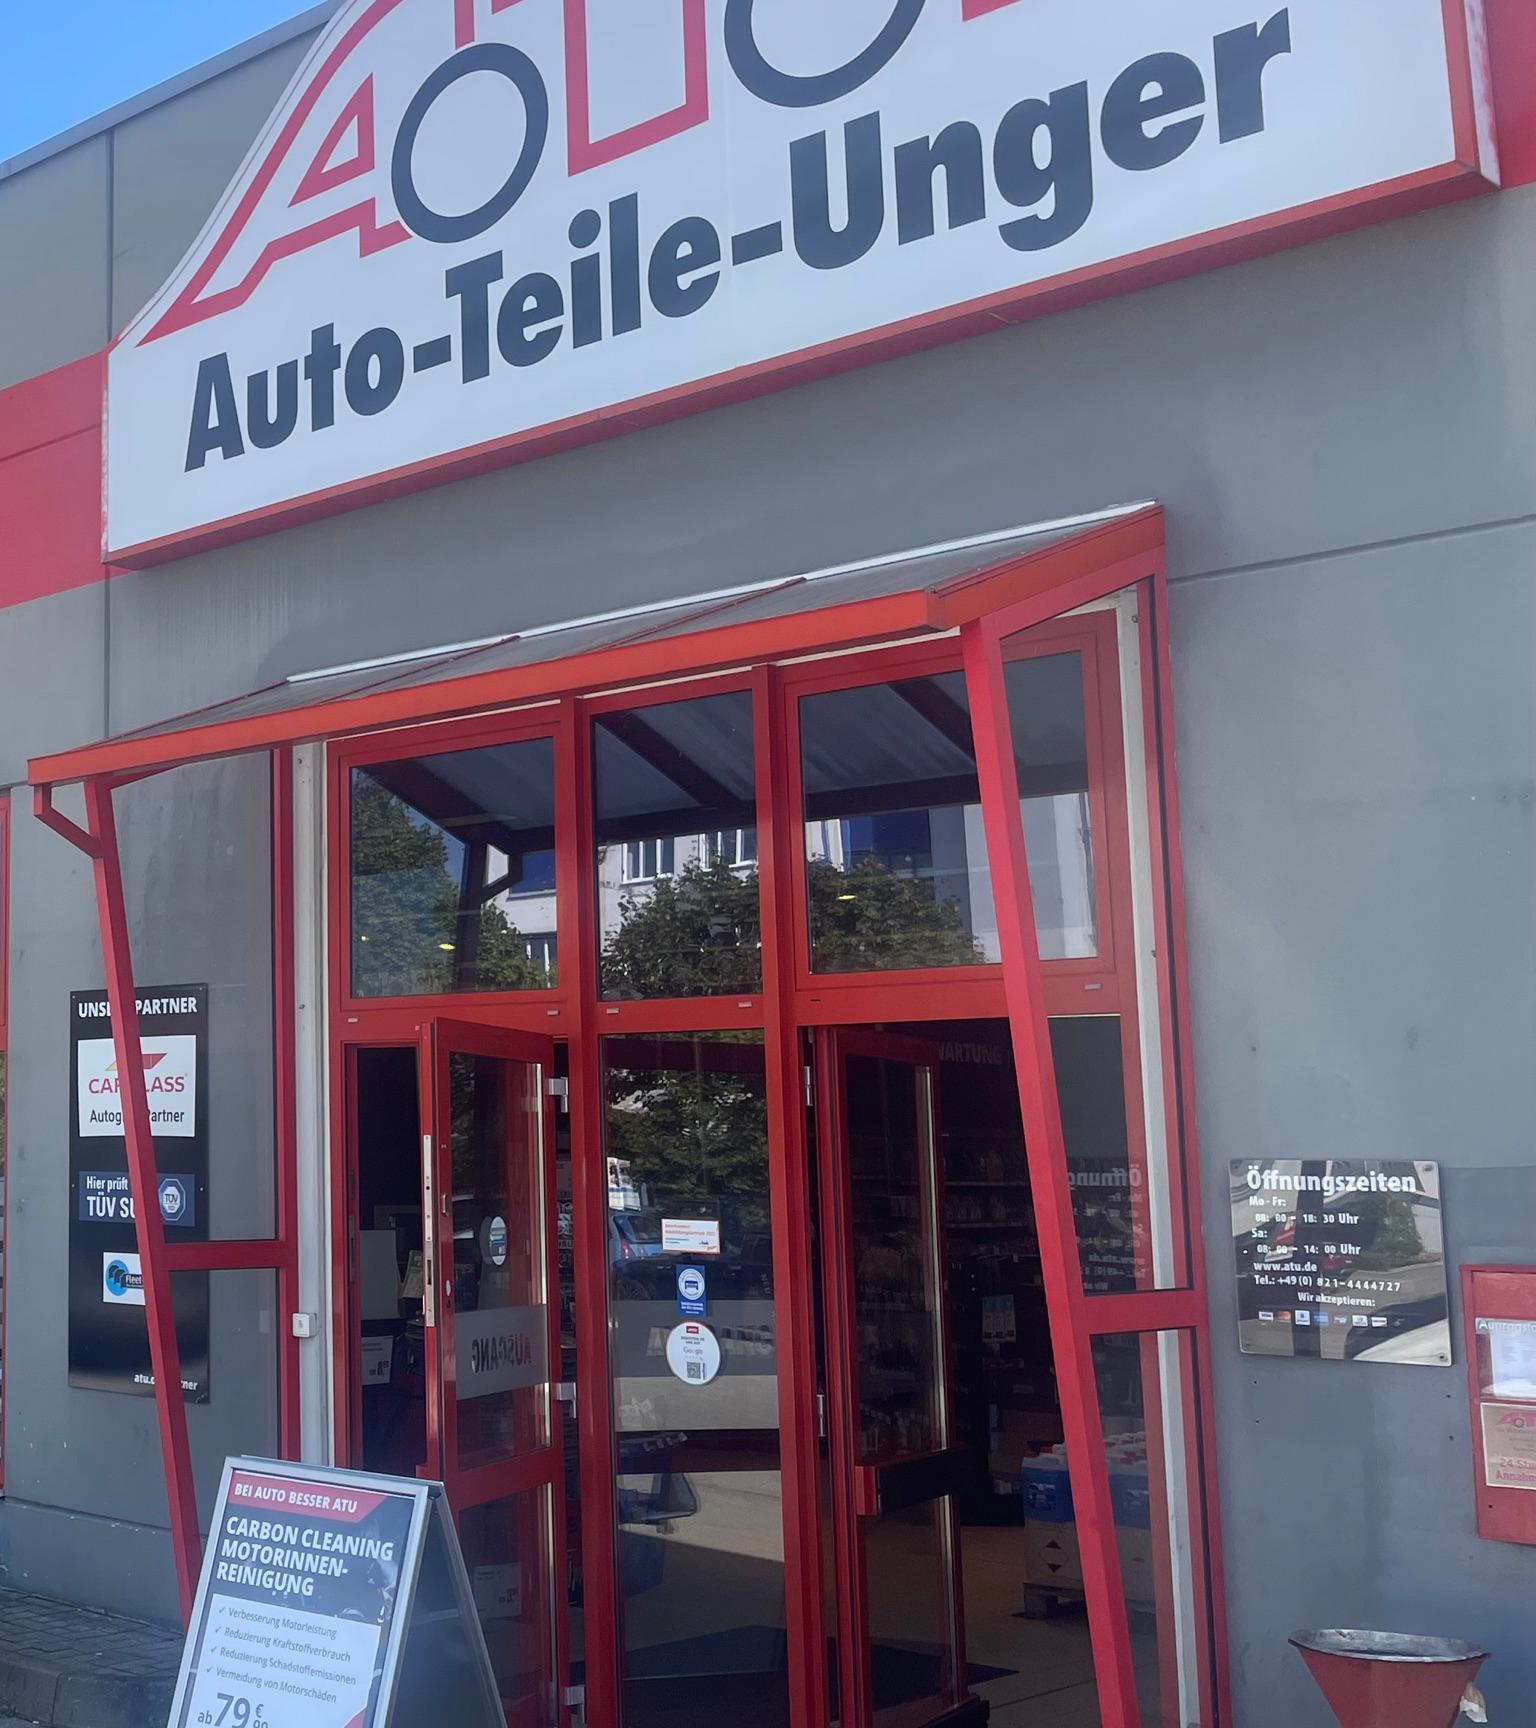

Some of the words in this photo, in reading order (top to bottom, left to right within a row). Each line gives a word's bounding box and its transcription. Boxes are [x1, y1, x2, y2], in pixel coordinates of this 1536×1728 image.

[184, 7, 1292, 472] Auto-Teile-Unger
[78, 1001, 112, 1018] UNS
[134, 996, 198, 1015] PARTNER
[86, 1175, 106, 1190] Hier
[107, 1176, 129, 1193] prüft
[1247, 1165, 1417, 1197] Öffnungszeiten
[86, 1191, 117, 1218] TÜV
[1249, 1196, 1264, 1207] Mo
[1272, 1196, 1287, 1207] Fr:
[1302, 1214, 1318, 1224] 18:
[1323, 1214, 1335, 1224] 30
[1338, 1212, 1360, 1225] Uhr
[1251, 1228, 1268, 1239] Sa:
[1304, 1245, 1319, 1255] 14:
[1324, 1245, 1337, 1255] 00
[1340, 1243, 1361, 1256] Uhr
[1253, 1261, 1318, 1272] www.atu.de
[1254, 1274, 1275, 1286] Tel.:
[1277, 1275, 1297, 1286] +49
[1298, 1276, 1313, 1287] (0)
[1297, 1291, 1314, 1303] Wir
[1315, 1292, 1376, 1307] akzeptieren:
[234, 1483, 252, 1496] BEI
[254, 1486, 286, 1501] AUTO
[288, 1491, 330, 1510] BESSER
[332, 1498, 358, 1513] ATU
[226, 1516, 299, 1545] CARBON
[301, 1528, 395, 1562] CLEANING
[221, 1539, 349, 1578] MOTORINNEN-
[216, 1561, 314, 1597] REINIGUNG
[229, 1607, 281, 1629] Verbesserung
[282, 1619, 337, 1640] Motorleistung
[224, 1627, 272, 1648] Reduzierung
[272, 1637, 351, 1662] Kraftstoffverbrauch
[216, 1666, 263, 1688] Vermeidung
[264, 1679, 279, 1690] von
[220, 1646, 268, 1668] Reduzierung
[269, 1657, 357, 1685] Schadstoffemissionen
[197, 1710, 213, 1725] ab
[214, 1692, 251, 1728] 79
[255, 1703, 265, 1718] €
